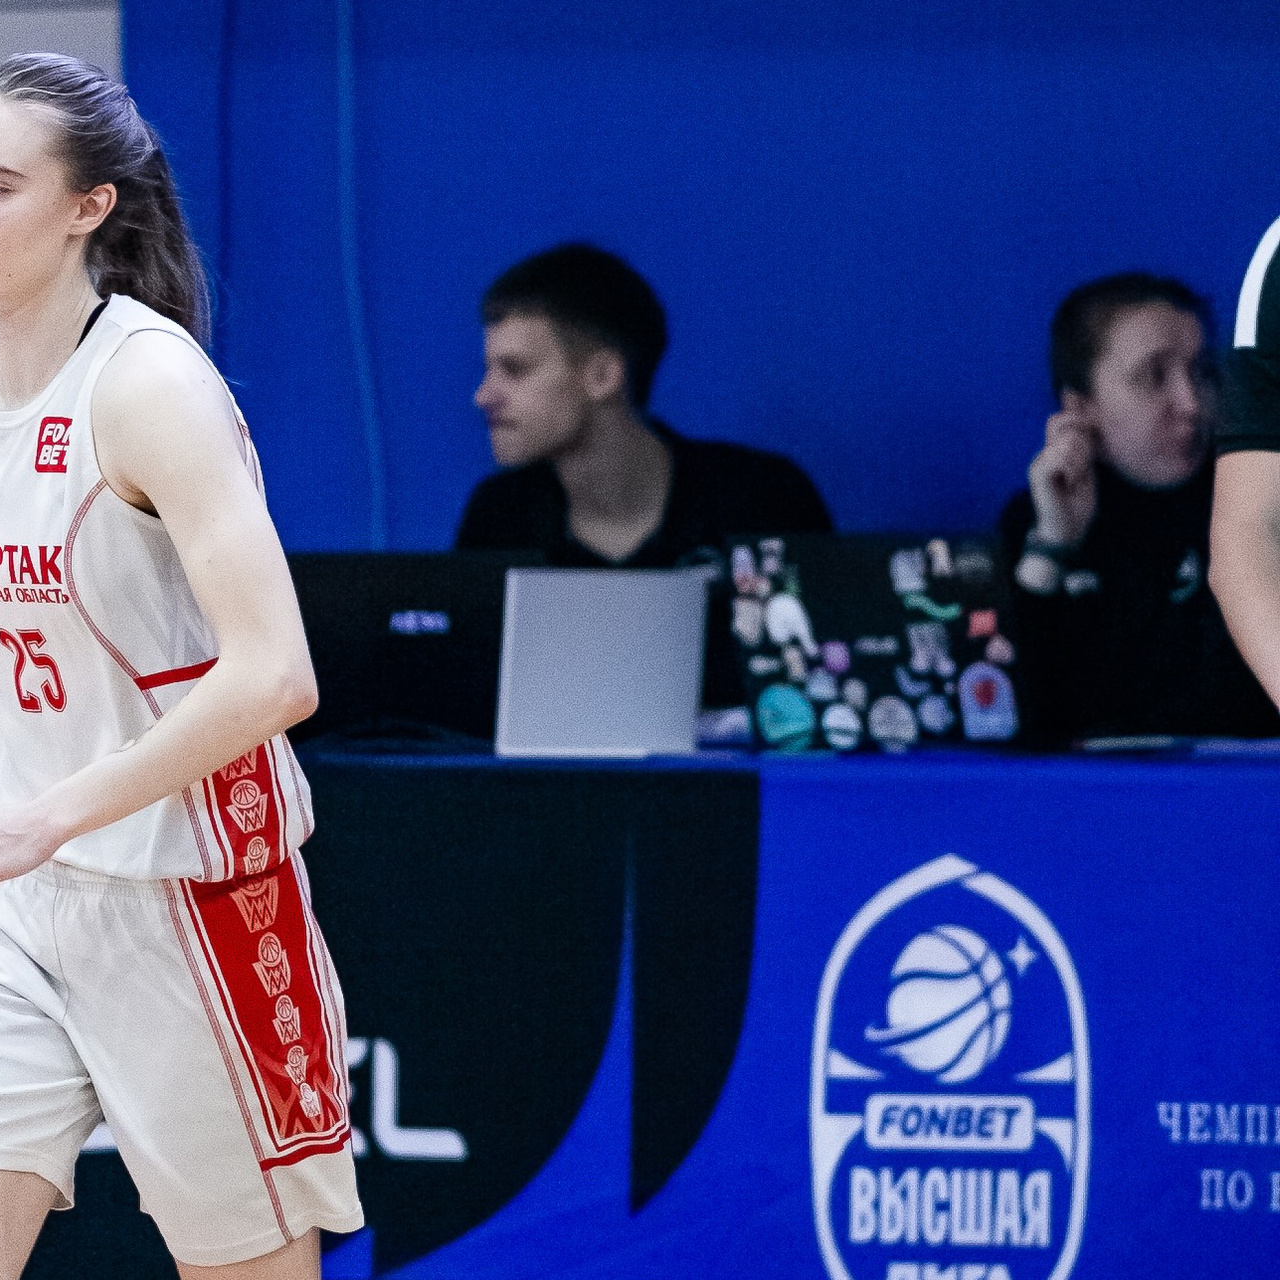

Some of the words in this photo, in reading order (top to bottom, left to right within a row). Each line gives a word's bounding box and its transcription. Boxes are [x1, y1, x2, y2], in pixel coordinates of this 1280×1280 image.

[15, 587, 70, 604] ОБЛАСТЬ
[878, 1104, 1021, 1139] FONBET
[1157, 1101, 1280, 1144] ЧЕМП
[849, 1166, 1051, 1248] ВЫСШАЯ
[1200, 1168, 1255, 1211] ПО
